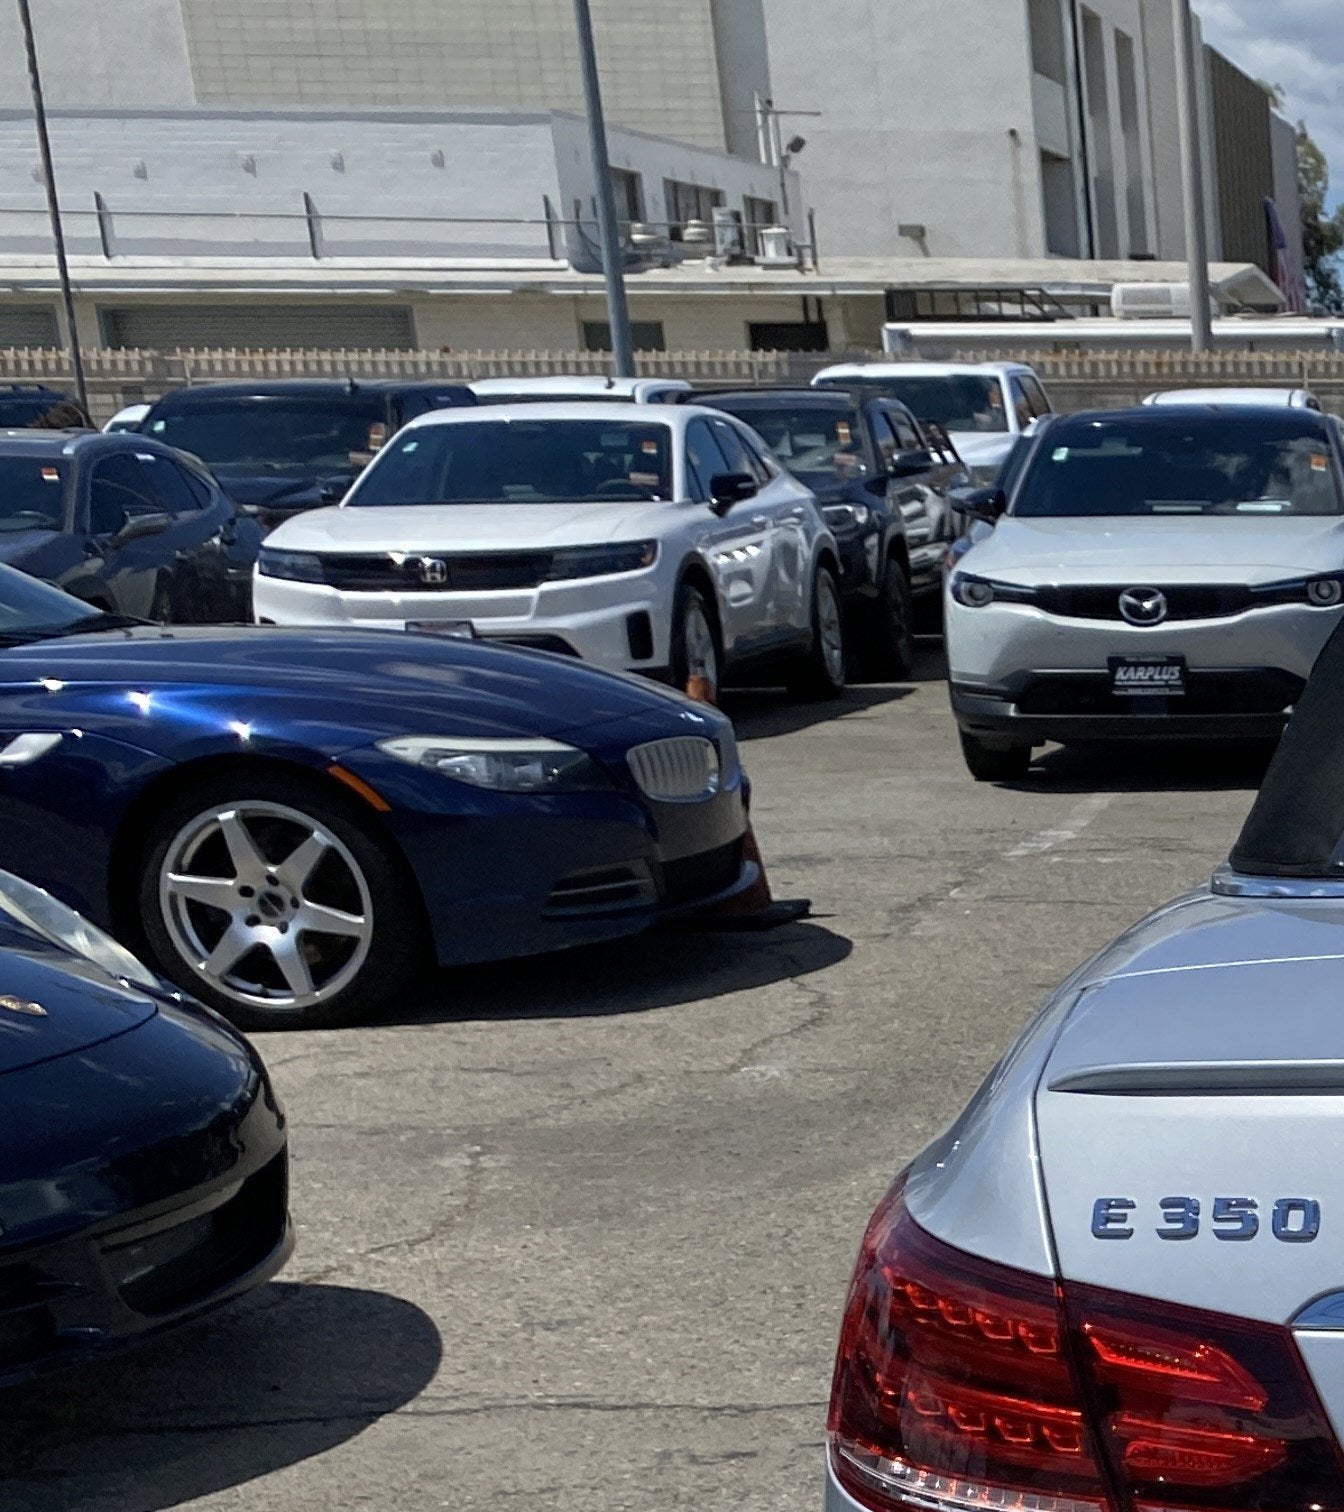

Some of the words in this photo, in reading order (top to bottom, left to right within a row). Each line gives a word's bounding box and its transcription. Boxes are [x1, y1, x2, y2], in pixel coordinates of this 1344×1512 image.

[1115, 666, 1181, 680] KARPLUS
[1091, 1197, 1137, 1240] E
[1155, 1196, 1321, 1243] 350
